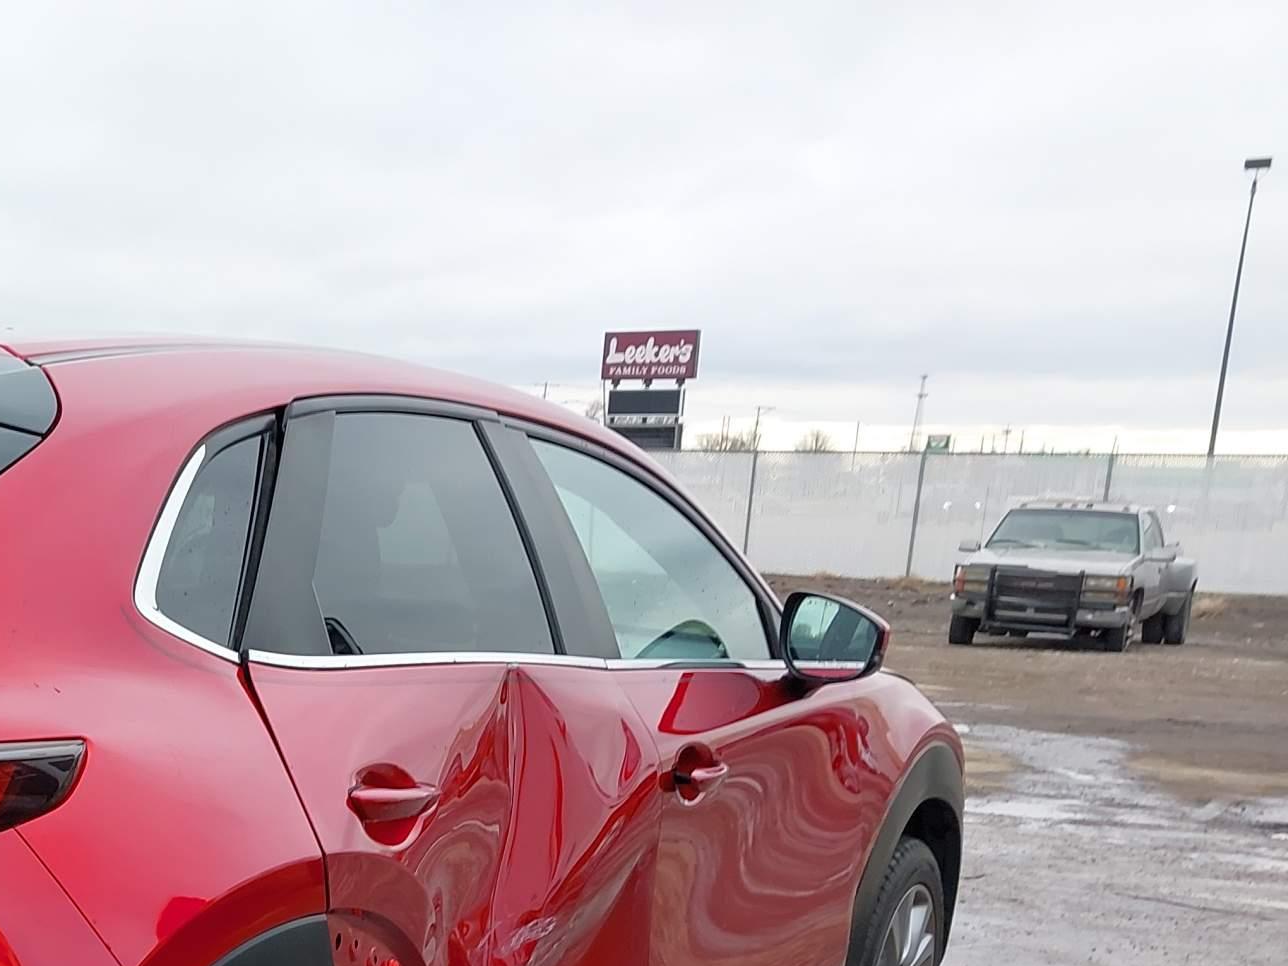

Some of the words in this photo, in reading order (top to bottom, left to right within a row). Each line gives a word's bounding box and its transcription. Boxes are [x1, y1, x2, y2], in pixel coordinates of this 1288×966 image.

[605, 336, 693, 364] Leeker's
[609, 365, 649, 375] FAMILY
[651, 364, 687, 375] FOODS
